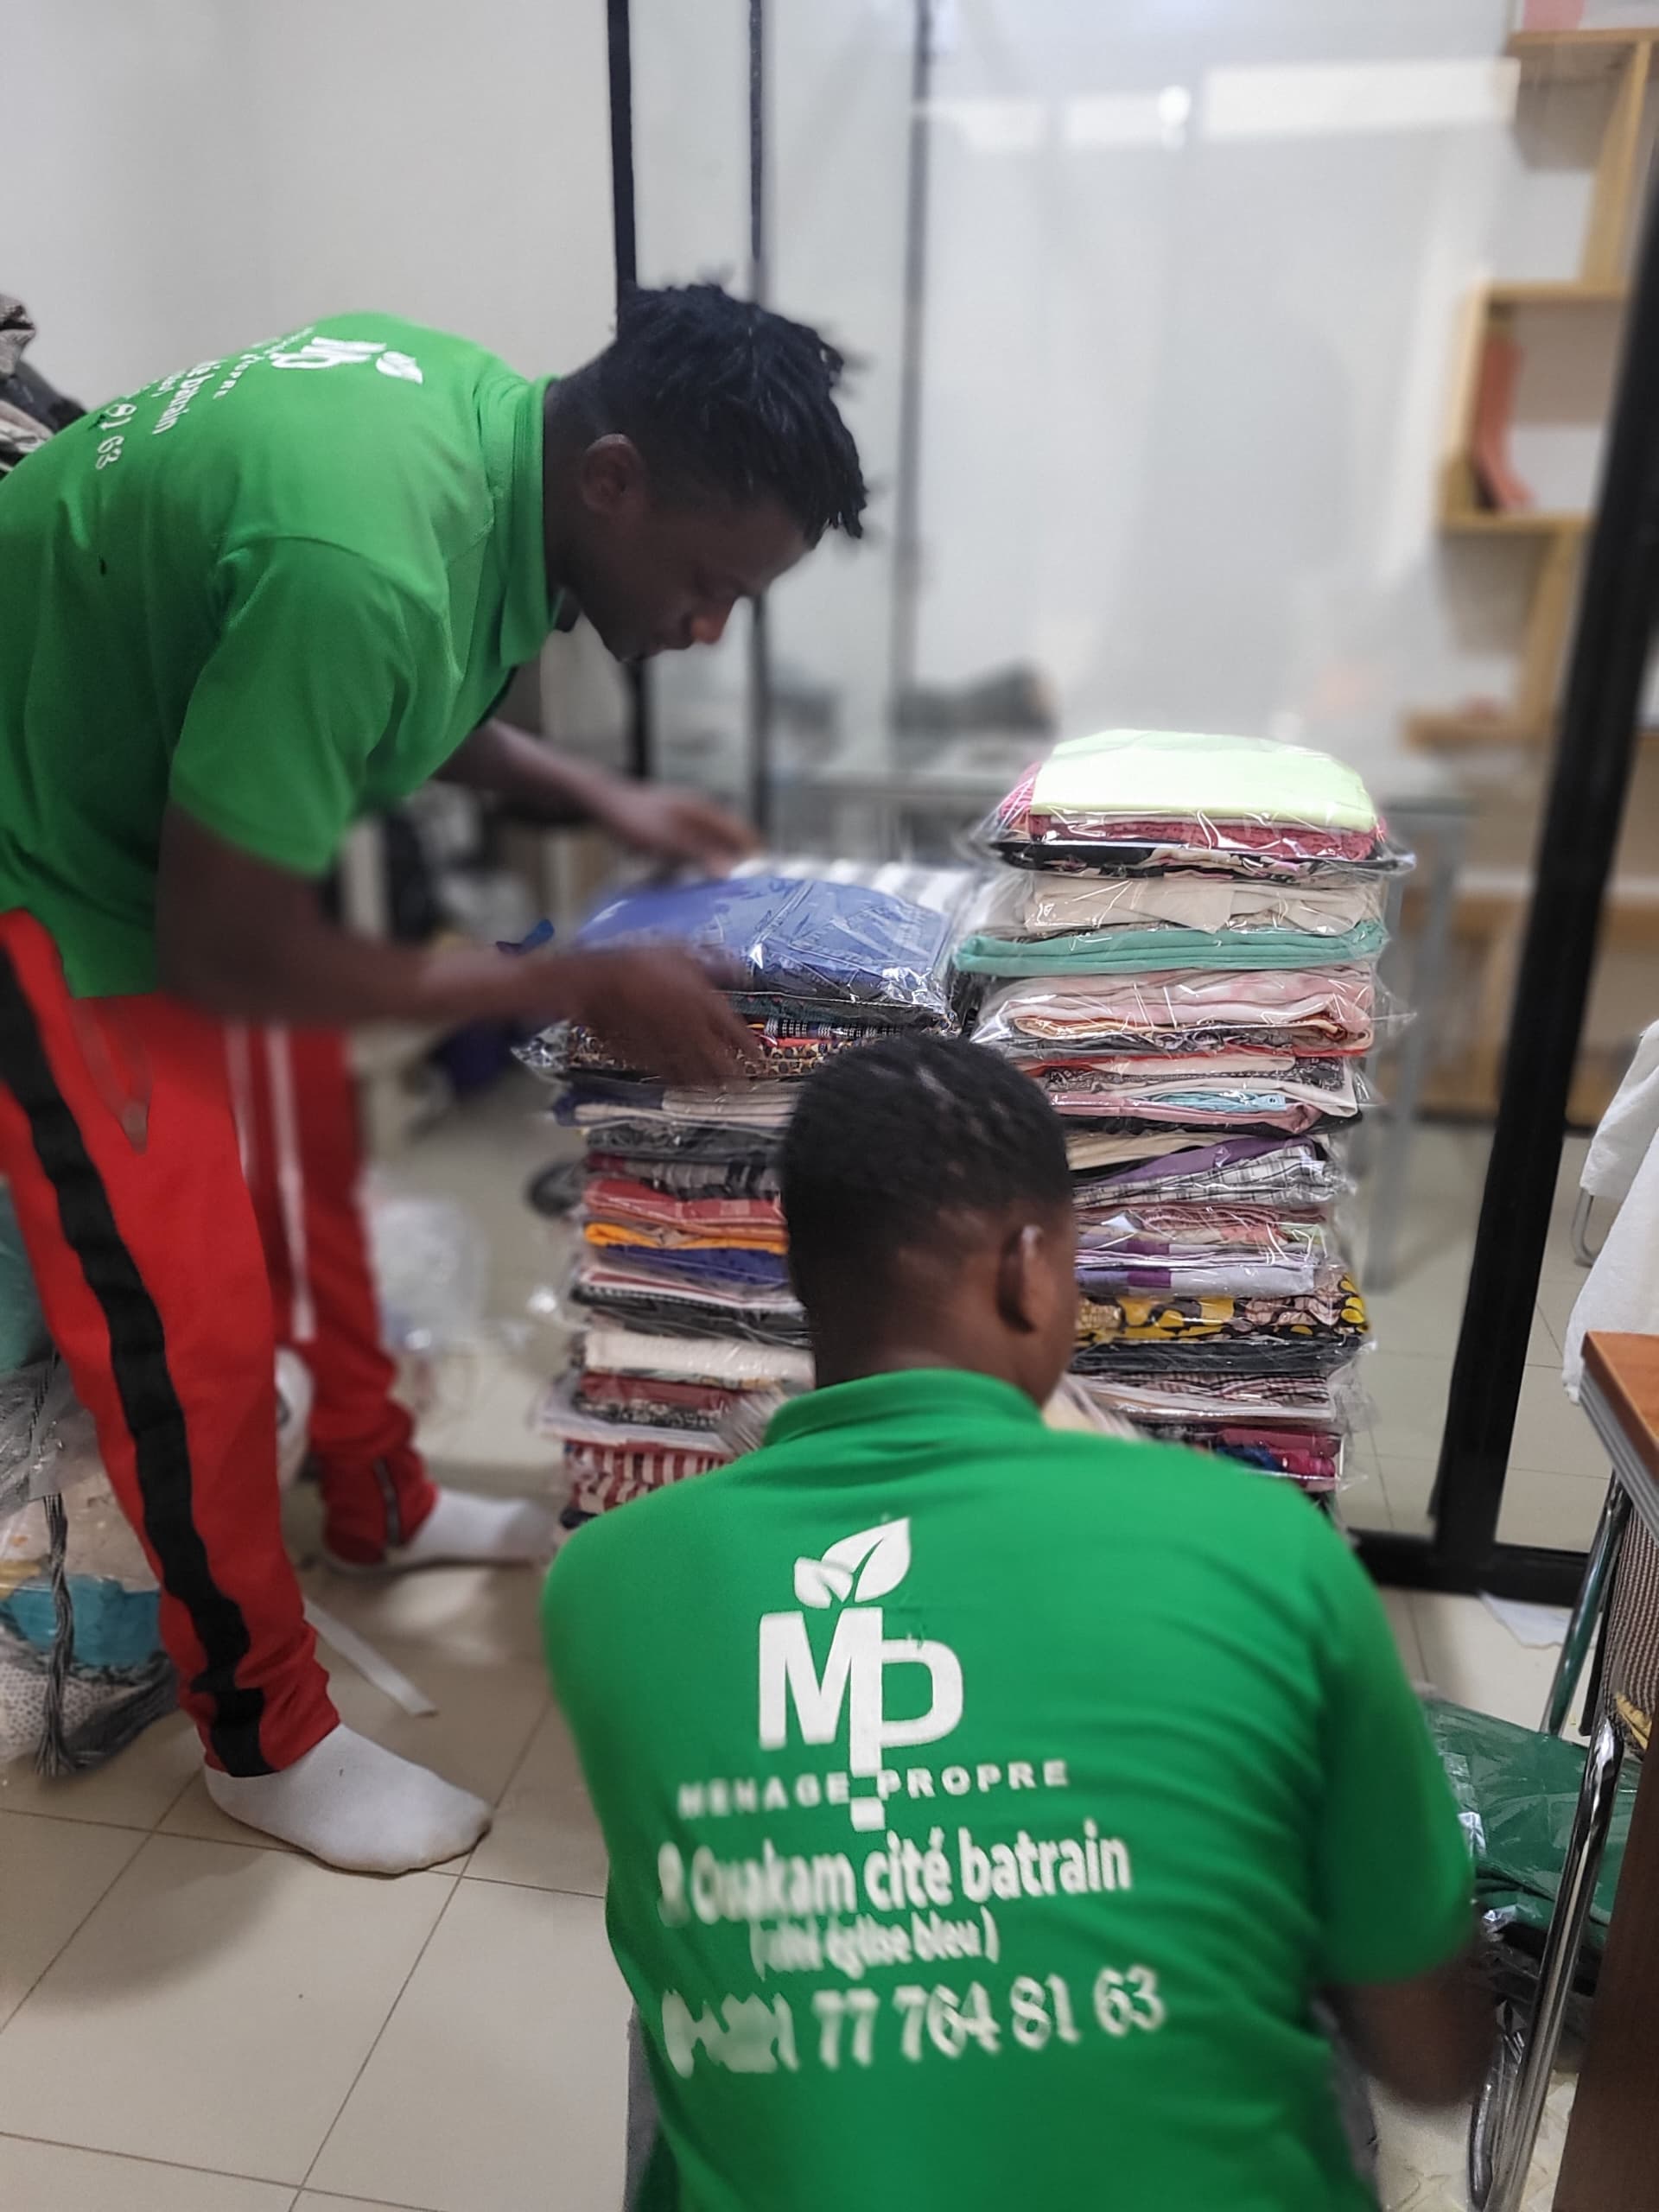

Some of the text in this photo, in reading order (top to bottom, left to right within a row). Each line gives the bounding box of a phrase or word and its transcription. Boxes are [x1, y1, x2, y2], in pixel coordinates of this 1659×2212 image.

[95, 435, 124, 470] 63
[877, 1759, 1069, 1800] PROPRE
[865, 1830, 952, 1911] cité
[957, 1818, 1131, 1902] batrain
[812, 1987, 880, 2070] 77
[892, 1980, 1002, 2062] 764
[1009, 1974, 1082, 2050] 81
[1094, 1965, 1167, 2037] 63
